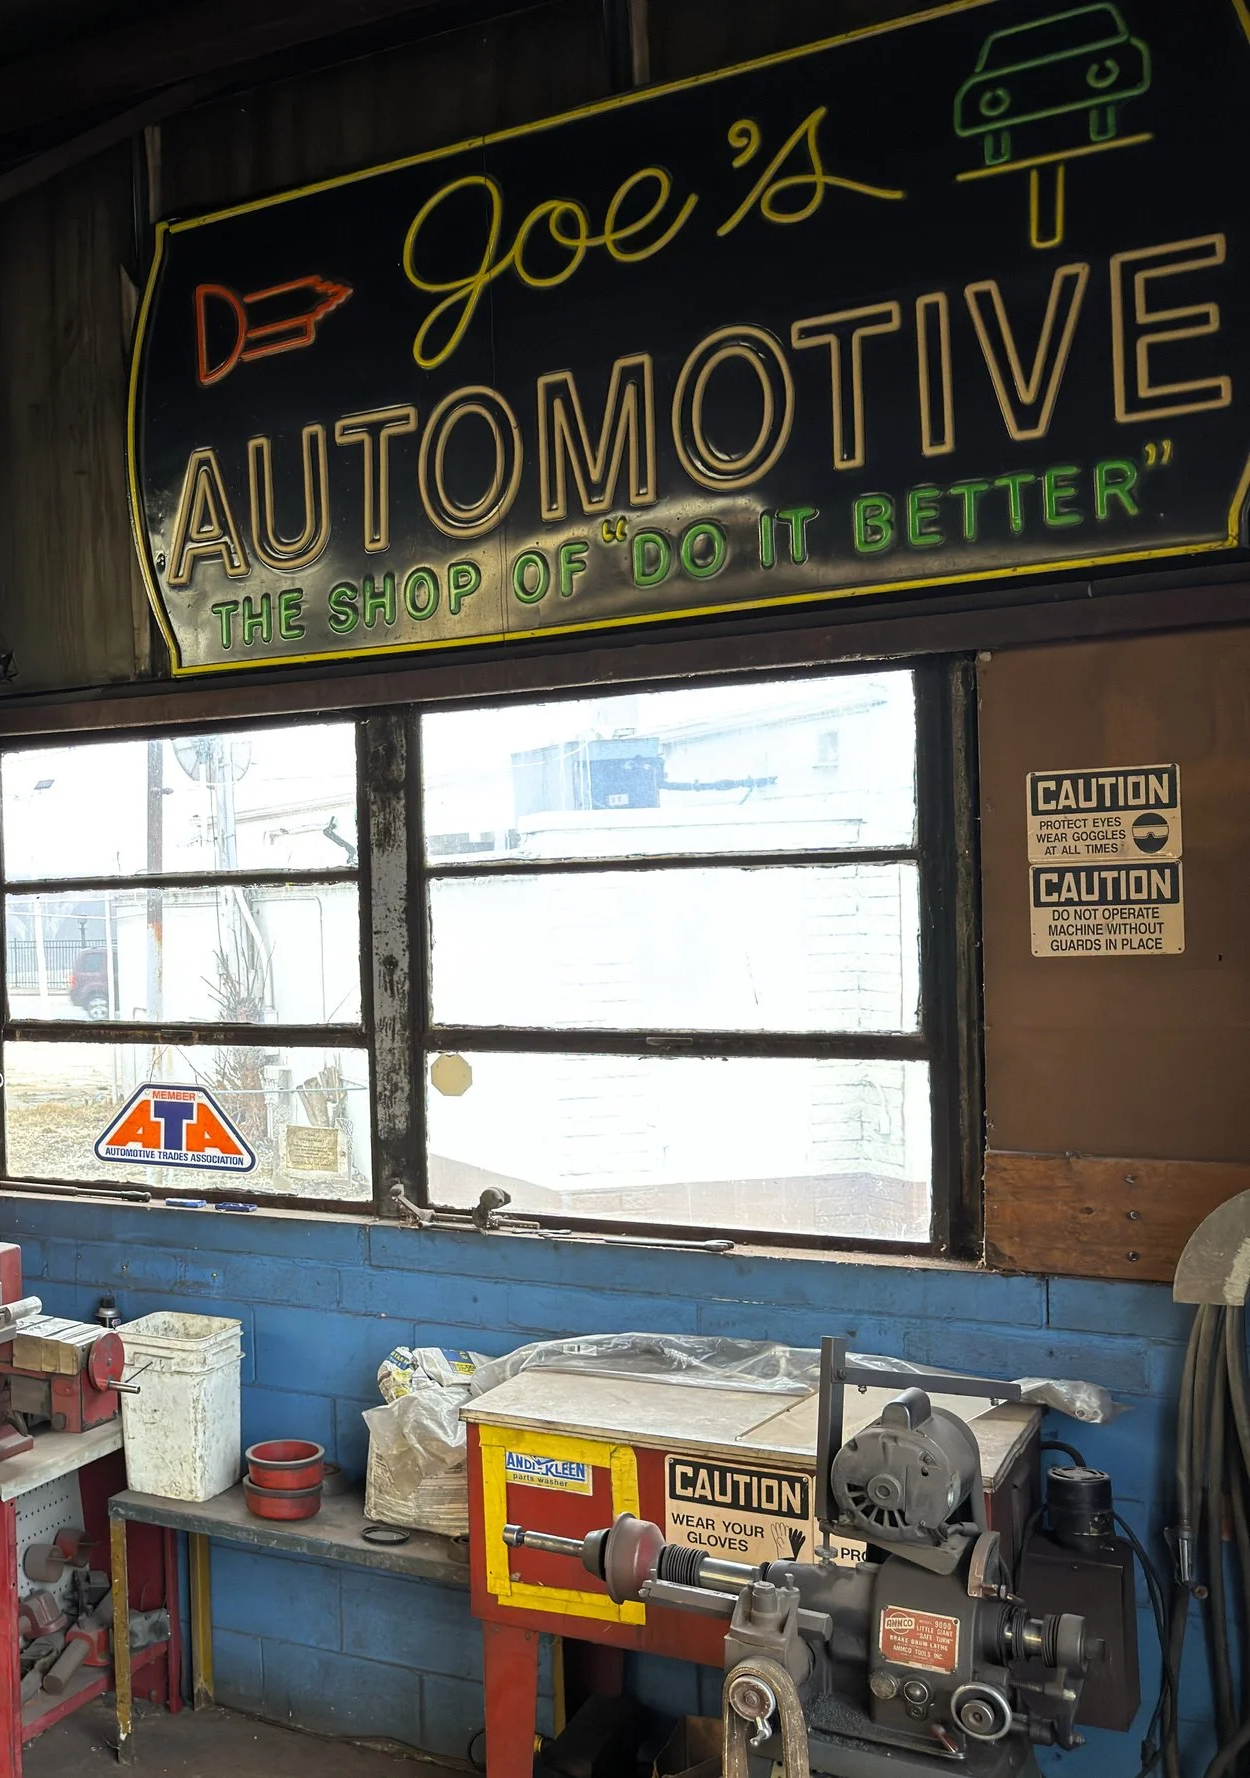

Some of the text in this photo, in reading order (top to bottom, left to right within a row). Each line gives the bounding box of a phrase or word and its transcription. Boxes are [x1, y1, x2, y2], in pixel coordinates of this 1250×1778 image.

[402, 106, 905, 369] Joe's
[168, 233, 1234, 589] AUTOMOTIVE
[210, 599, 306, 651] THE
[327, 561, 485, 636] SHOP
[511, 539, 590, 606] OF
[759, 506, 822, 571] IT
[1037, 773, 1169, 811] CAUTION
[1039, 816, 1122, 831] PROTECT EYES
[1036, 829, 1126, 843] WEAR GOGGLES
[1044, 843, 1119, 856] AT ALL TIMES
[1039, 868, 1172, 903] CAUTION
[1052, 906, 1160, 921] DO NOT OPERATE
[1048, 922, 1164, 937] MACHINE WITHOUT
[1050, 938, 1163, 951] GUARDS IN PLACE
[152, 1089, 196, 1101] MEMBER
[106, 1099, 244, 1156] ATA
[105, 1147, 244, 1166] AUTOMOTIVE TRADES ASSOCIATION
[507, 1452, 586, 1479] ANDI-KLEEN
[512, 1473, 568, 1487] parts washer
[675, 1464, 801, 1514] CAUTION
[671, 1512, 765, 1539] WEAR YOUR
[687, 1531, 749, 1552] GLOVES
[886, 1619, 913, 1628] AMMCO
[916, 1624, 953, 1637] LITTLE GIANT
[889, 1634, 949, 1651] BRAKE DRUM LATHE
[893, 1644, 912, 1653] AMMCO
[914, 1648, 931, 1658] TOOLS
